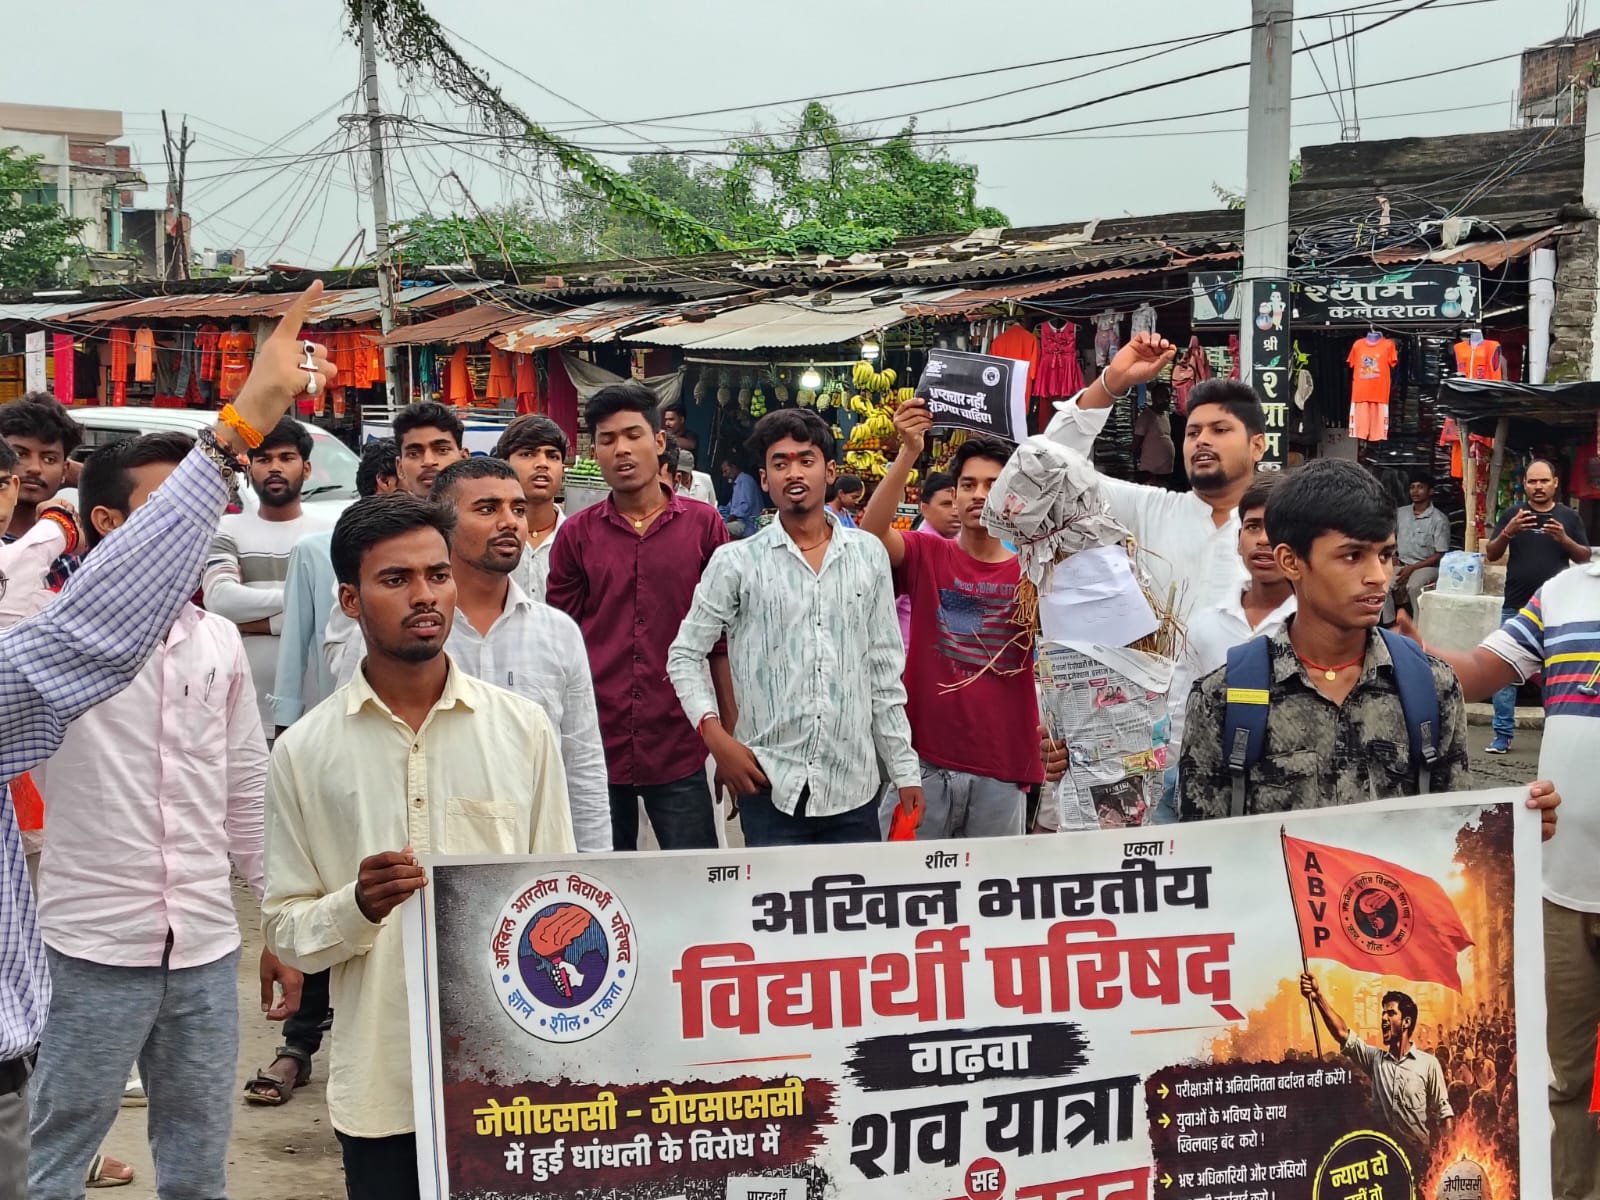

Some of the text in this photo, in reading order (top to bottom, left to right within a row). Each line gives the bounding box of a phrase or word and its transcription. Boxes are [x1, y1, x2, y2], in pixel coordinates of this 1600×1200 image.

[1328, 301, 1438, 319] कलेक्शन
[1263, 335, 1279, 352] श्री
[925, 852, 958, 869] शील
[1123, 840, 1163, 858] एकता
[707, 866, 740, 883] ज्ञान
[752, 858, 1212, 936] अखिल भारतीय
[672, 919, 1245, 1040] विद्यार्थी परिषद्
[549, 1012, 581, 1034] शील
[590, 981, 623, 1018] एकता
[909, 1034, 1032, 1081] गढ़वा
[1175, 1078, 1213, 1098] परीक्षाओं
[1215, 1077, 1223, 1095] में
[1225, 1075, 1275, 1094] अनियमितता
[1306, 1069, 1323, 1087] नहीं
[1325, 1067, 1346, 1085] करेंगे
[473, 1091, 618, 1137] जेपीएससी
[649, 1076, 805, 1125] जेएसएससी
[1176, 1103, 1287, 1133] युवाओं के भविष्य के साथ
[850, 1074, 1141, 1180] शव यात्रा
[1177, 1134, 1219, 1154] खिलवाड़
[1220, 1132, 1235, 1150] बंद
[1238, 1129, 1258, 1147] करो
[504, 1123, 781, 1181] में हुई धांधली के विरोध में
[970, 1168, 1000, 1193] सह
[1250, 1163, 1267, 1182] और
[1269, 1159, 1308, 1180] एजेंसियों
[1329, 1150, 1389, 1188] न्याय दो
[1443, 1174, 1482, 1192] जेपीएससी
